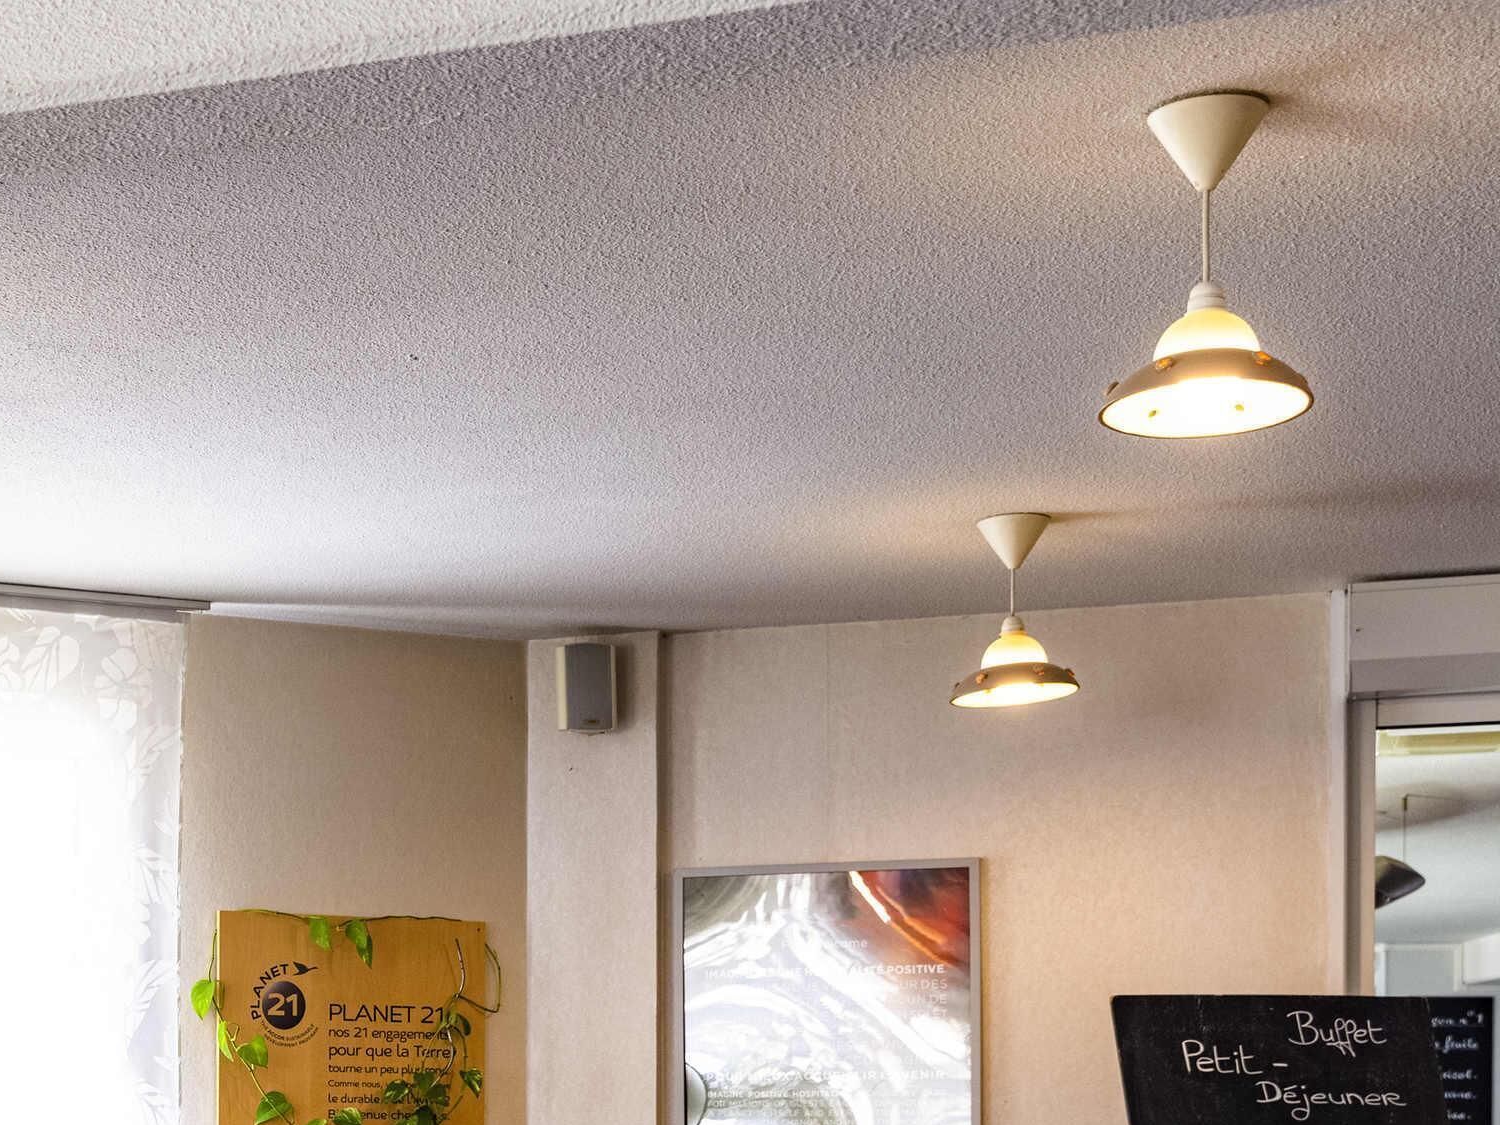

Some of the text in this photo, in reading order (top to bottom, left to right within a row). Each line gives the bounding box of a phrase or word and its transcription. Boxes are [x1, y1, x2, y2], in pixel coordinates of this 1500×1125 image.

[886, 963, 946, 975] POSITIVE
[250, 963, 289, 1020] PLANET
[267, 992, 298, 1017] 21
[329, 1004, 444, 1024] PLANET 21
[328, 1028, 350, 1038] nos
[354, 1027, 368, 1038] 21
[1286, 1011, 1387, 1057] Buffet
[328, 1046, 361, 1060] pour
[365, 1046, 392, 1061] que
[396, 1044, 410, 1057] la
[1182, 1039, 1263, 1075] Petit
[328, 1064, 362, 1073] tourne
[380, 1066, 399, 1076] peu
[328, 1080, 360, 1088] Comme
[328, 1093, 380, 1104] le durable
[390, 1110, 414, 1120] che
